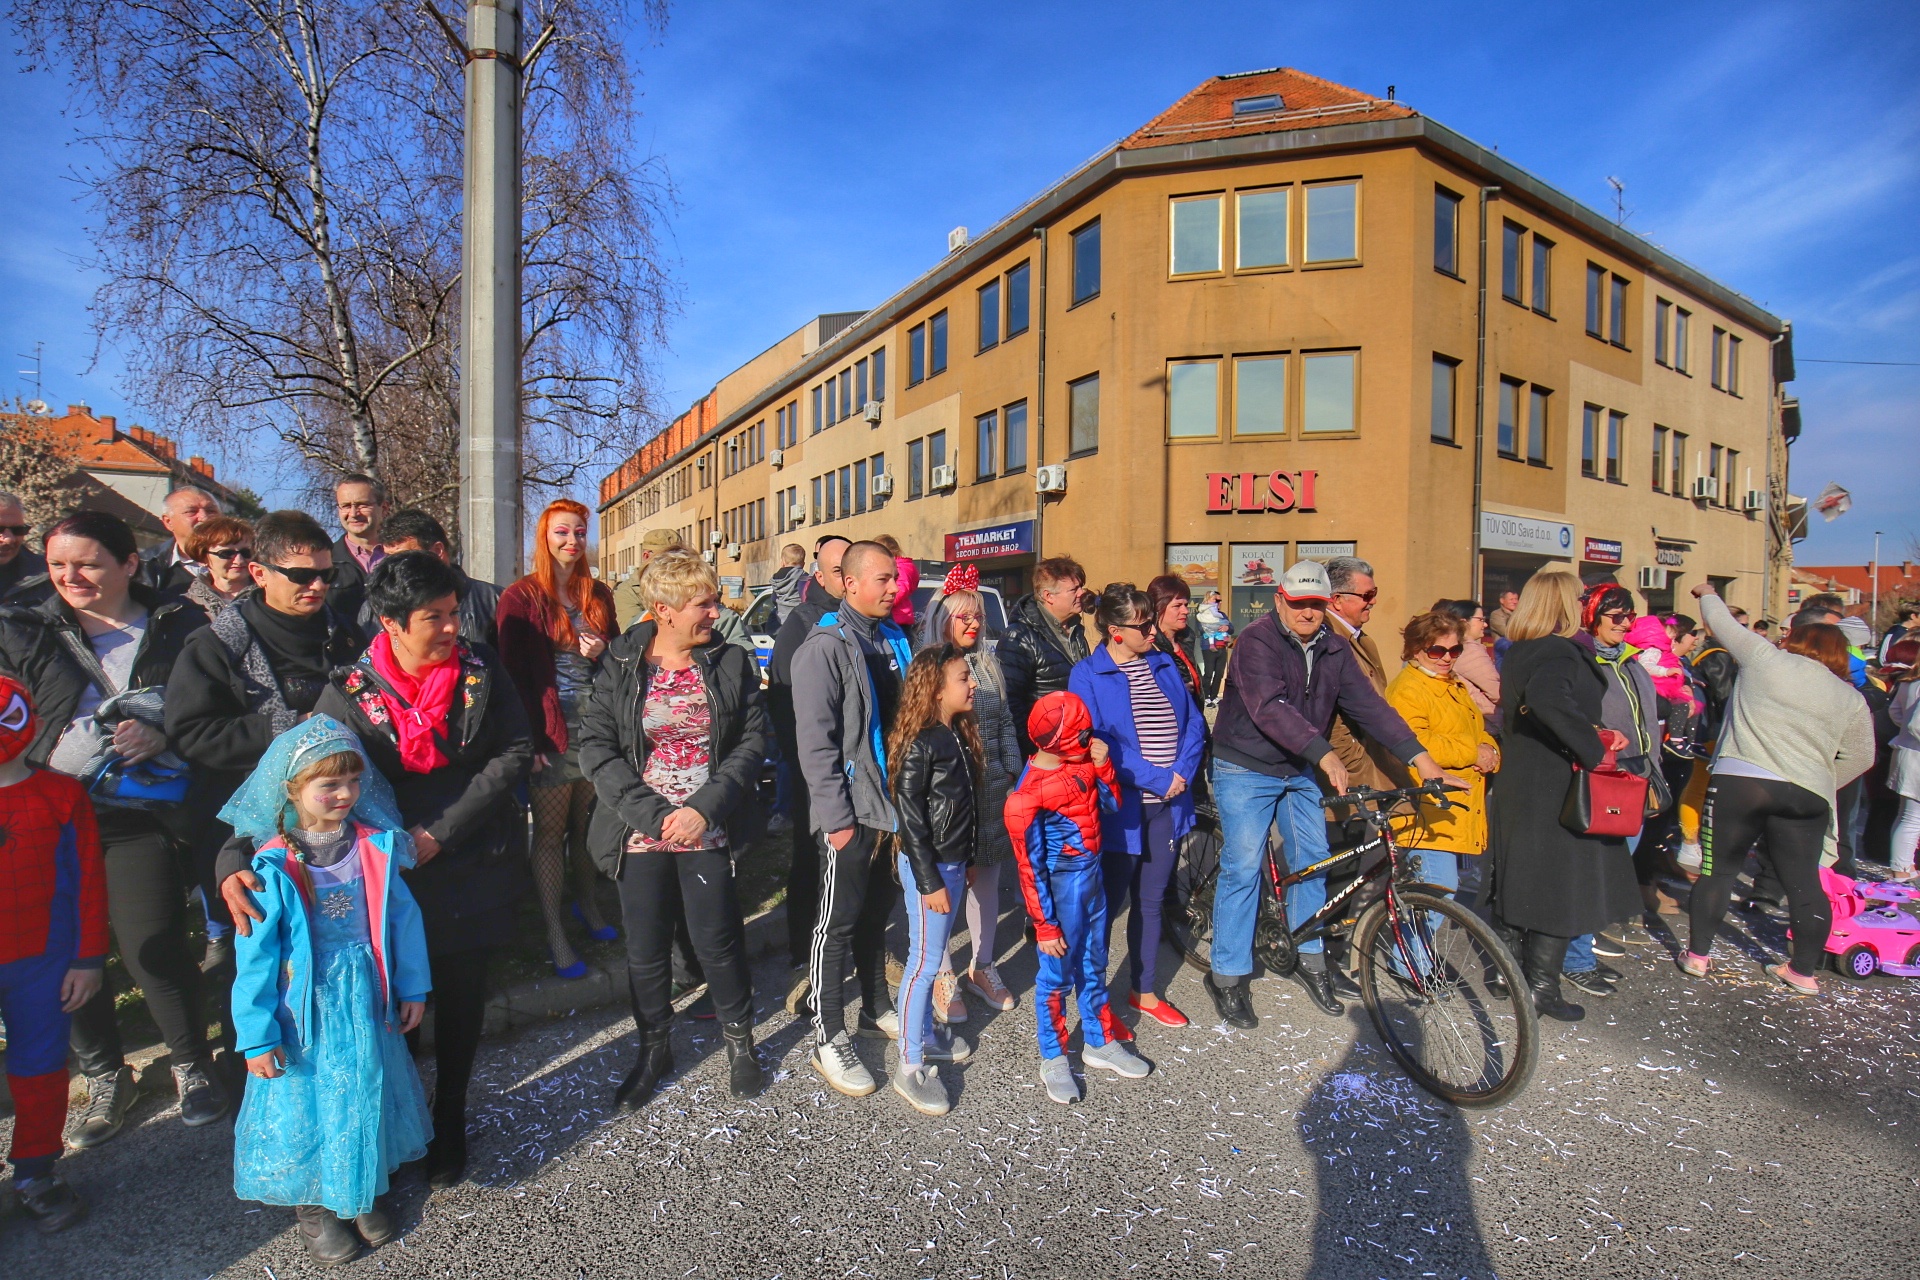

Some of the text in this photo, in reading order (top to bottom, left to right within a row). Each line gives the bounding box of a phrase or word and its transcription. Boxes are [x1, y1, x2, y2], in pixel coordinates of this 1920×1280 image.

[1207, 470, 1318, 511] ELSI
[958, 528, 1017, 546] TEXMARKET
[1486, 517, 1500, 533] TÜV
[1502, 520, 1517, 536] SÜD
[1518, 523, 1534, 538] Sava
[1535, 526, 1552, 541] d.o.o.
[956, 543, 1019, 558] SECOND HAND SHOP
[1242, 550, 1275, 559] KOLAČI
[1300, 546, 1320, 554] KRUH
[1327, 546, 1352, 554] PECIVO
[1588, 542, 1621, 553] TEXMARKET
[1314, 850, 1355, 871] Phantom
[1356, 845, 1365, 854] 18
[1365, 838, 1381, 850] speed
[1315, 875, 1365, 918] POWER
